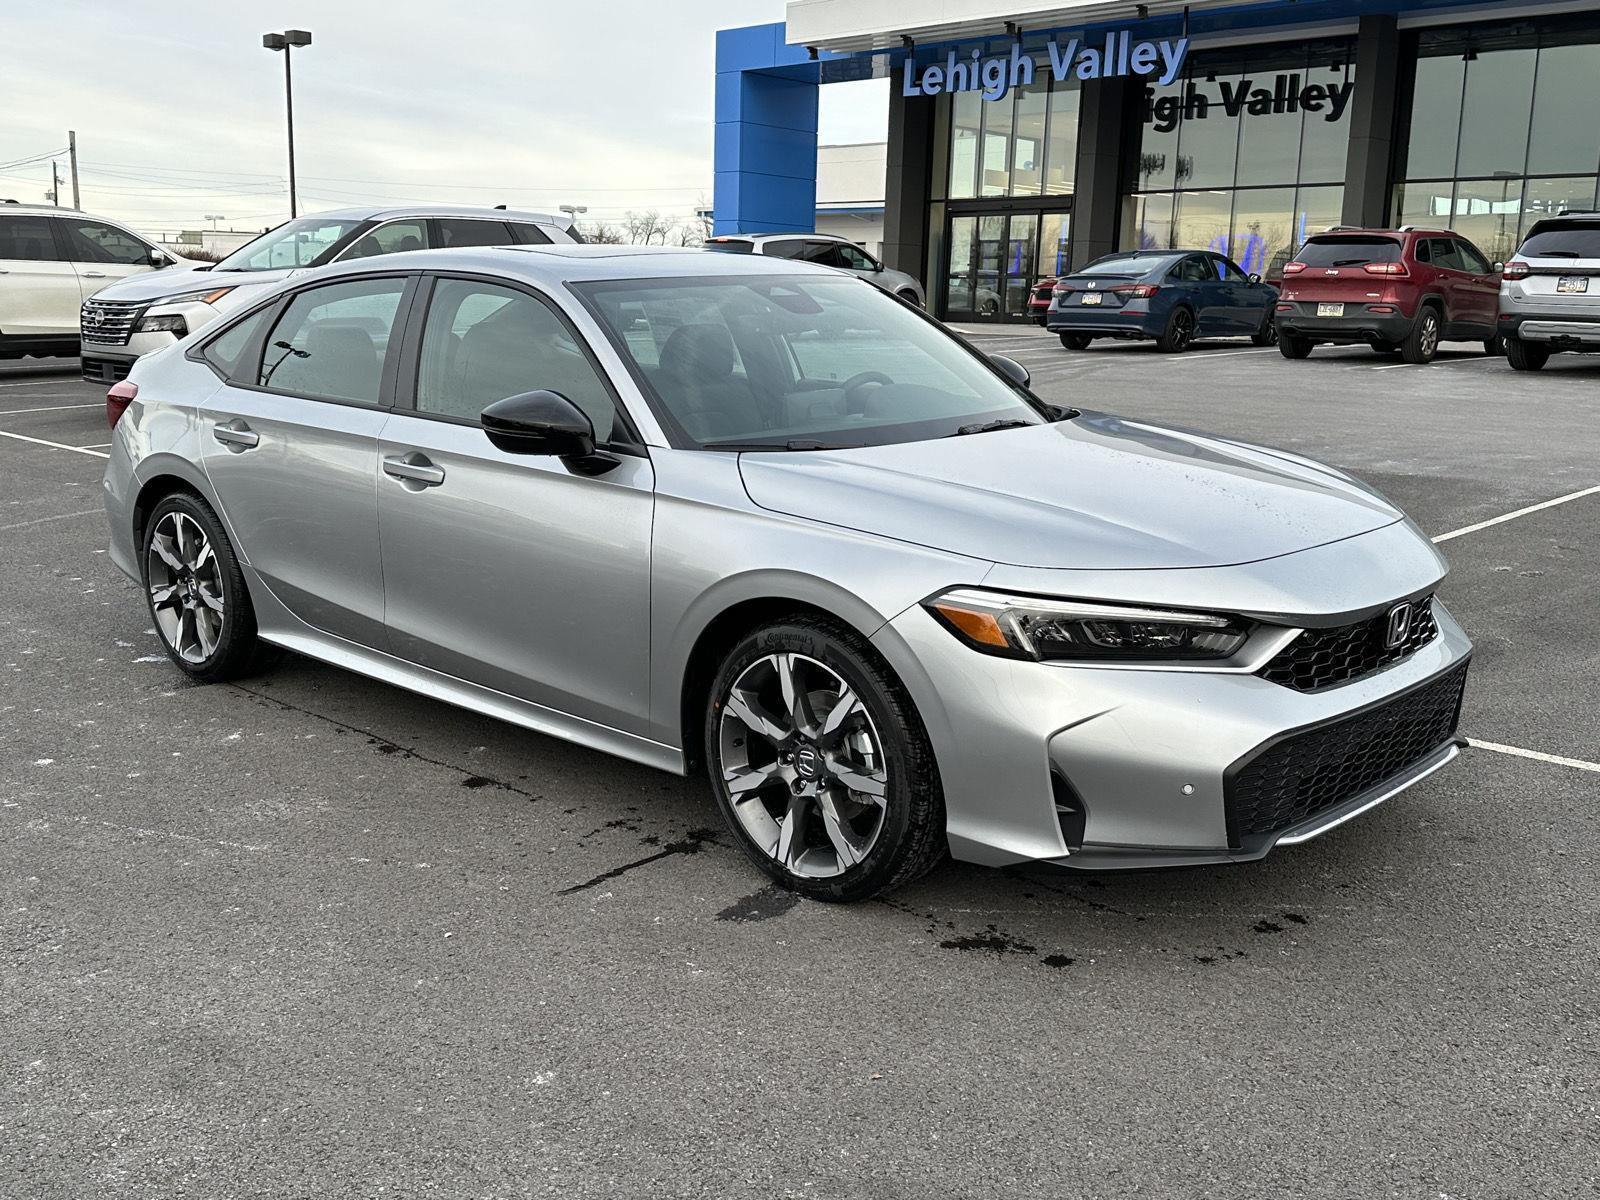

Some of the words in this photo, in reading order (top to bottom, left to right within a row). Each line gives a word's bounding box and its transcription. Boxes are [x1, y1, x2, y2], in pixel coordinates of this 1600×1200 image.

[903, 42, 1035, 101] Lehigh
[1047, 29, 1190, 87] Valley
[1219, 73, 1354, 122] Valley
